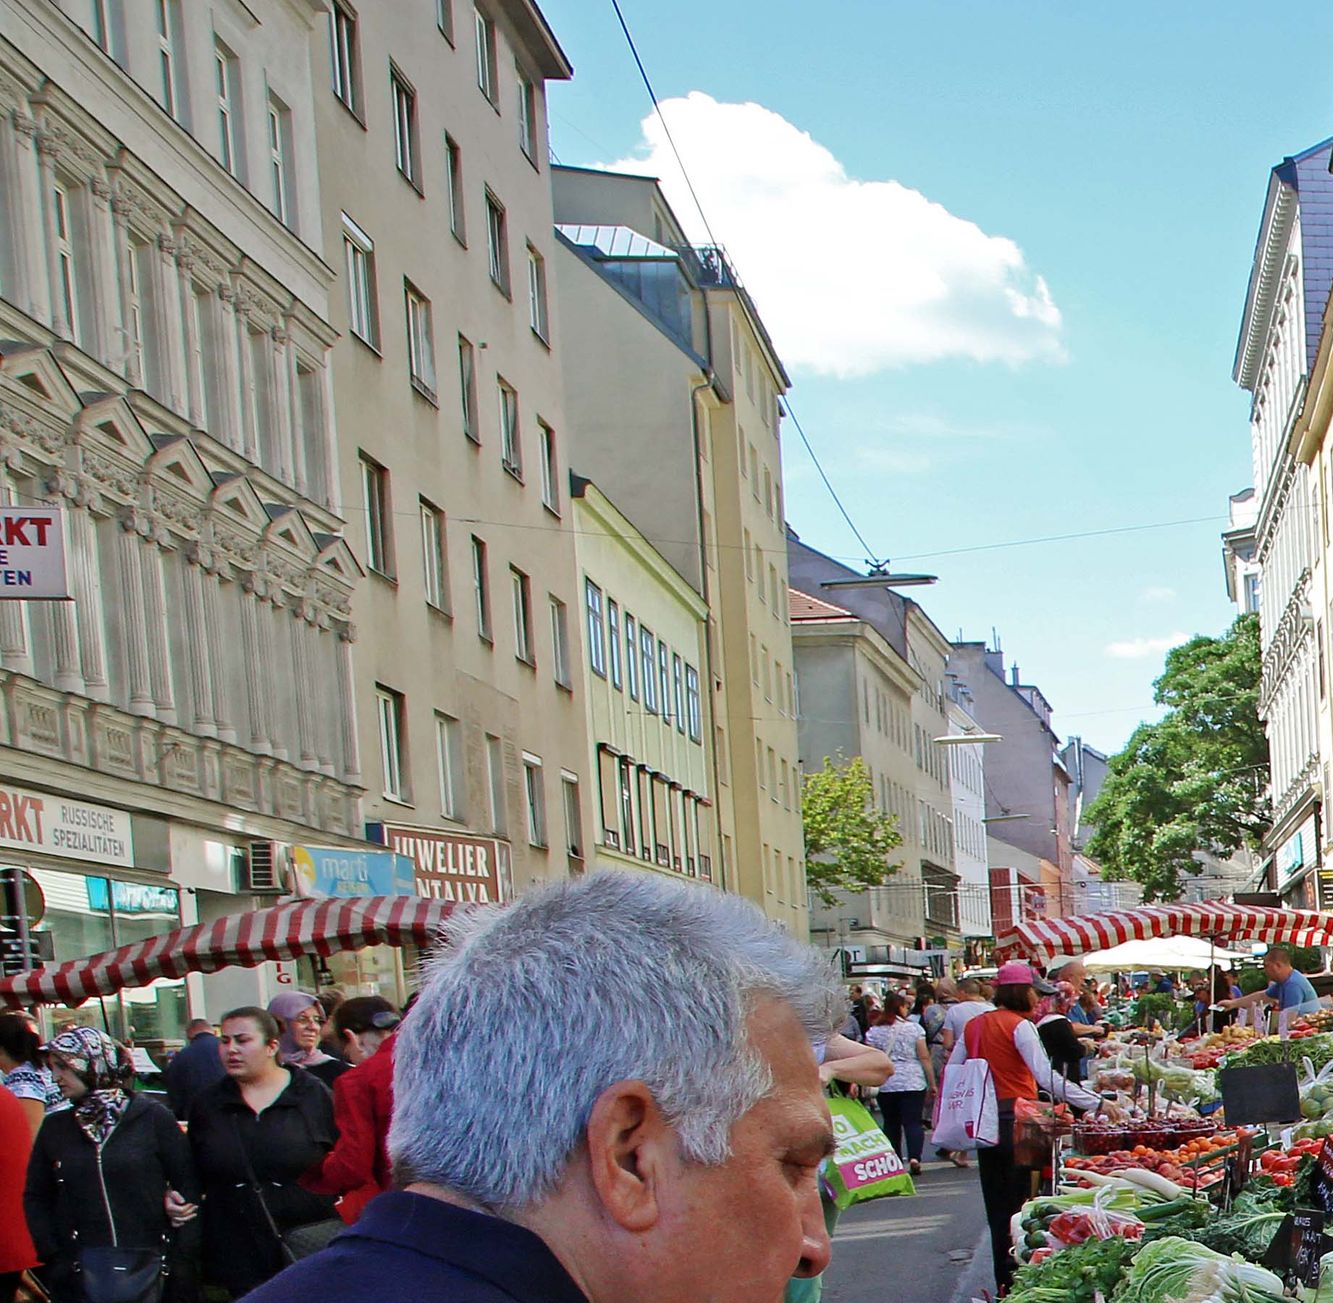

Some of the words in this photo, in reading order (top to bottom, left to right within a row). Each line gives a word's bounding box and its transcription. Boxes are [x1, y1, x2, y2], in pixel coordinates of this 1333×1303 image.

[0, 516, 52, 547] KT
[0, 570, 32, 586] EN
[61, 805, 115, 833] RUSSISCHE
